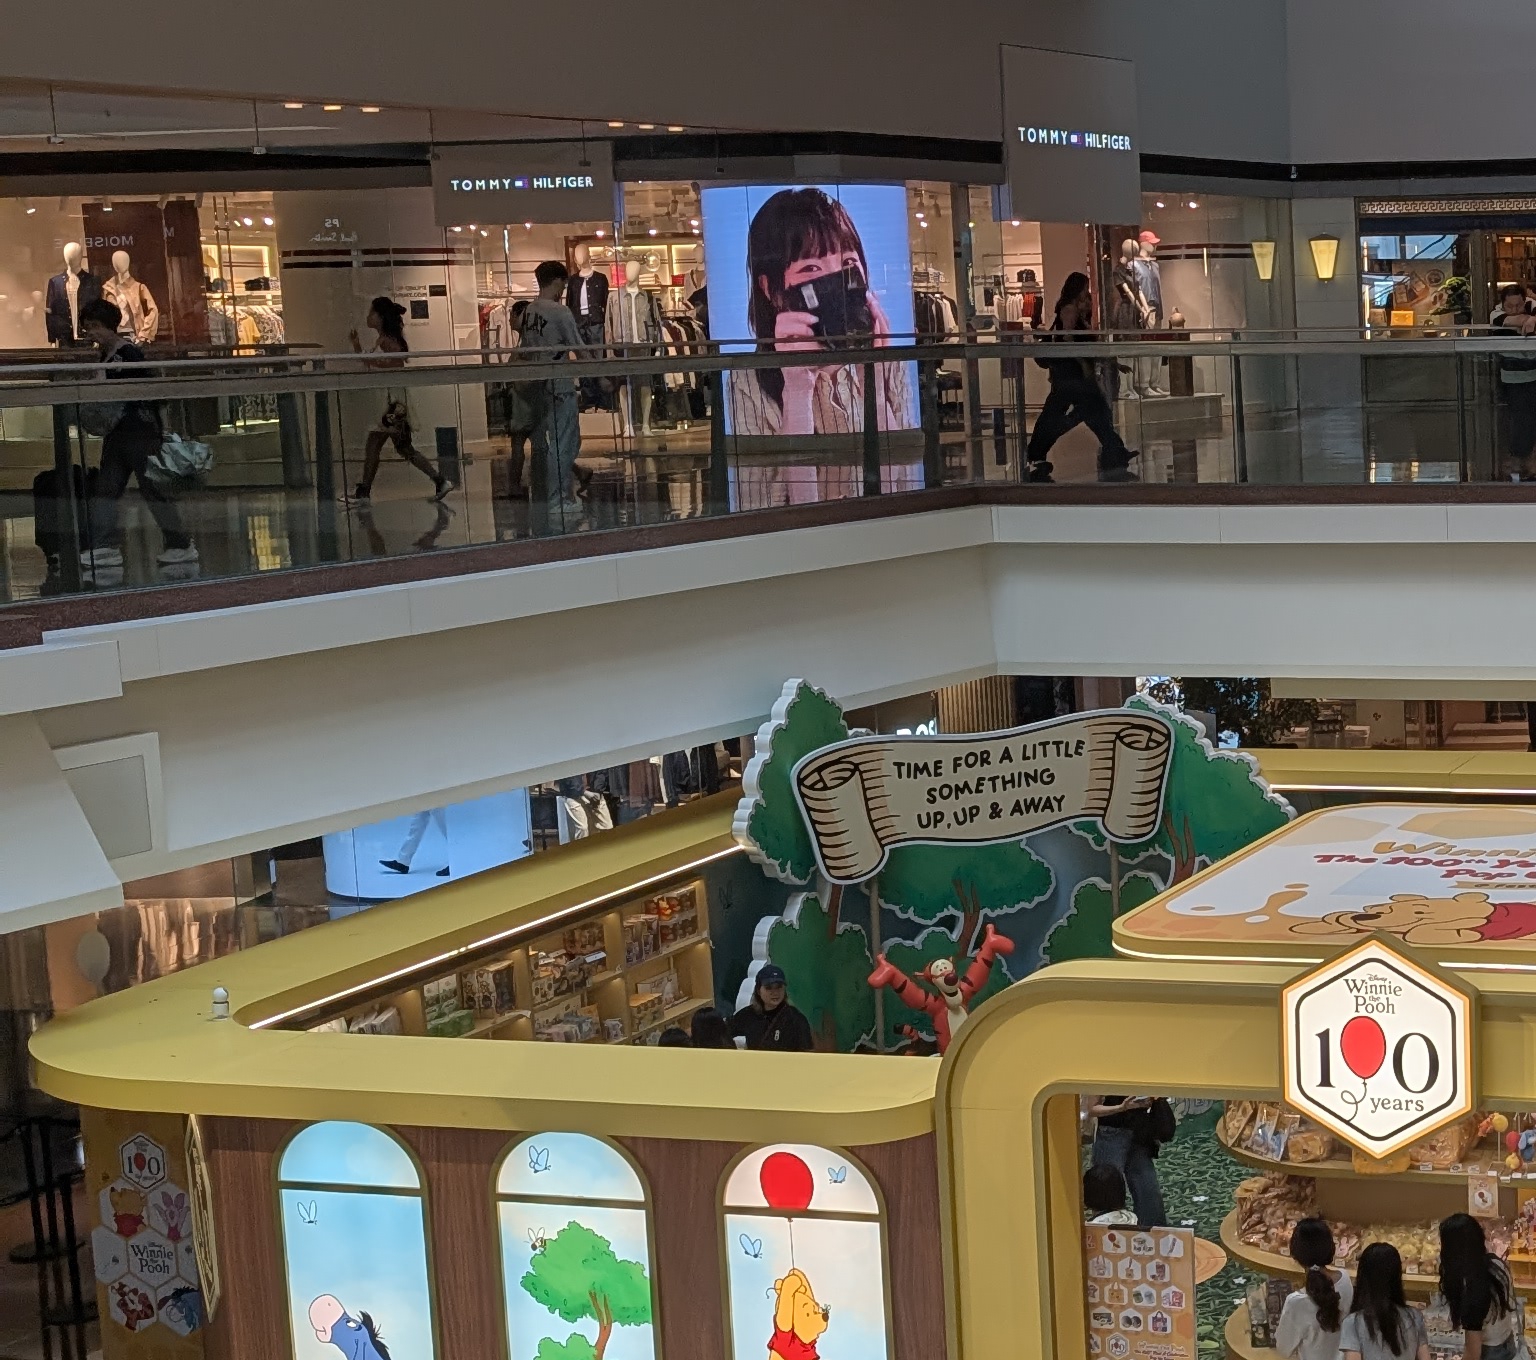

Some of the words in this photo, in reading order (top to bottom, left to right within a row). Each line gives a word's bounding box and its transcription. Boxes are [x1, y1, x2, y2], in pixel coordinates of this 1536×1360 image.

[1018, 126, 1068, 146] TOMMY
[1084, 132, 1132, 152] HILFIGER
[450, 178, 511, 191] TOMMY
[533, 176, 594, 189] HILFIGER
[892, 759, 944, 780] TIME
[952, 749, 992, 774] FOR
[998, 746, 1014, 764] A
[1021, 739, 1086, 762] LITTLE
[926, 767, 1056, 805] SOMETHING
[988, 801, 1004, 820] &
[1009, 794, 1066, 817] AWAY
[1313, 854, 1379, 864] The
[1382, 856, 1488, 867] 100th
[1440, 868, 1518, 881] Pop
[1342, 978, 1403, 997] Winnie
[1353, 994, 1396, 1015] Pooh
[1369, 1096, 1425, 1114] years
[130, 1243, 174, 1260] Winnie
[138, 1257, 170, 1275] Pooh
